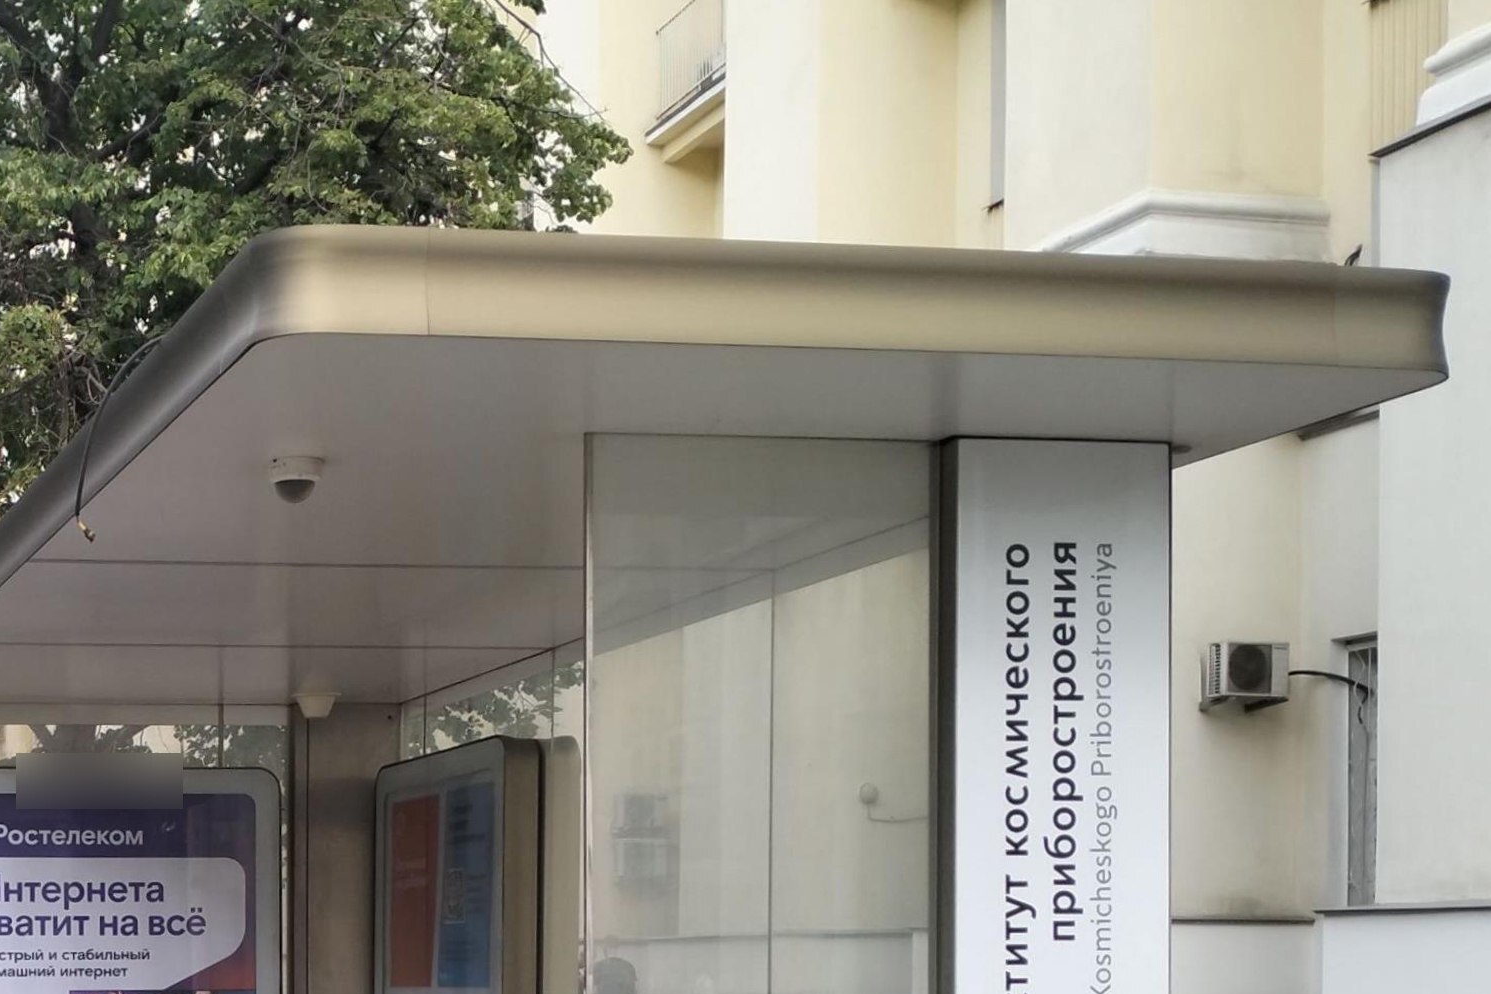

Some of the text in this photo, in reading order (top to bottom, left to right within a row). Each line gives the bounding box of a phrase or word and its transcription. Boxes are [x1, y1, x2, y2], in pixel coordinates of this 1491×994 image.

[1005, 543, 1030, 856] космического
[1090, 542, 1117, 777] Priborostroeniya
[1043, 542, 1085, 941] приборостроения
[48, 951, 58, 961] и
[61, 948, 151, 961] стабильный
[60, 965, 128, 978] интернет
[98, 914, 140, 937] на
[147, 907, 207, 937] всё
